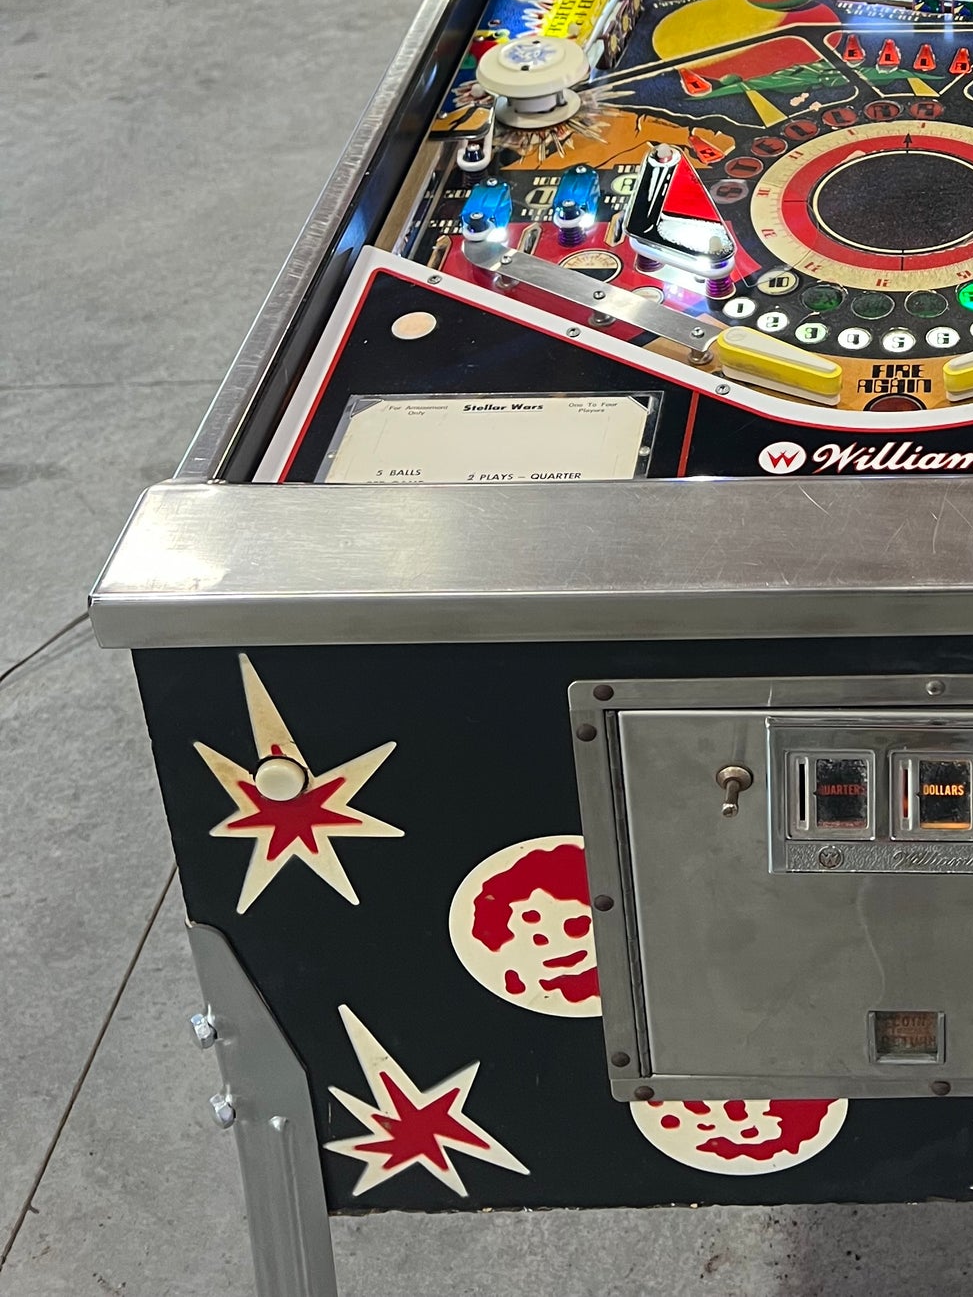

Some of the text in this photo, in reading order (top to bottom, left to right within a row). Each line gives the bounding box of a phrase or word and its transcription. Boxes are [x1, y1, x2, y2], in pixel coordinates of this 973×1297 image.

[872, 364, 925, 379] FIRE
[857, 378, 932, 394] AGAIN
[511, 403, 544, 411] Wars
[530, 472, 582, 480] QUARTER
[922, 783, 965, 797] DOLLARS
